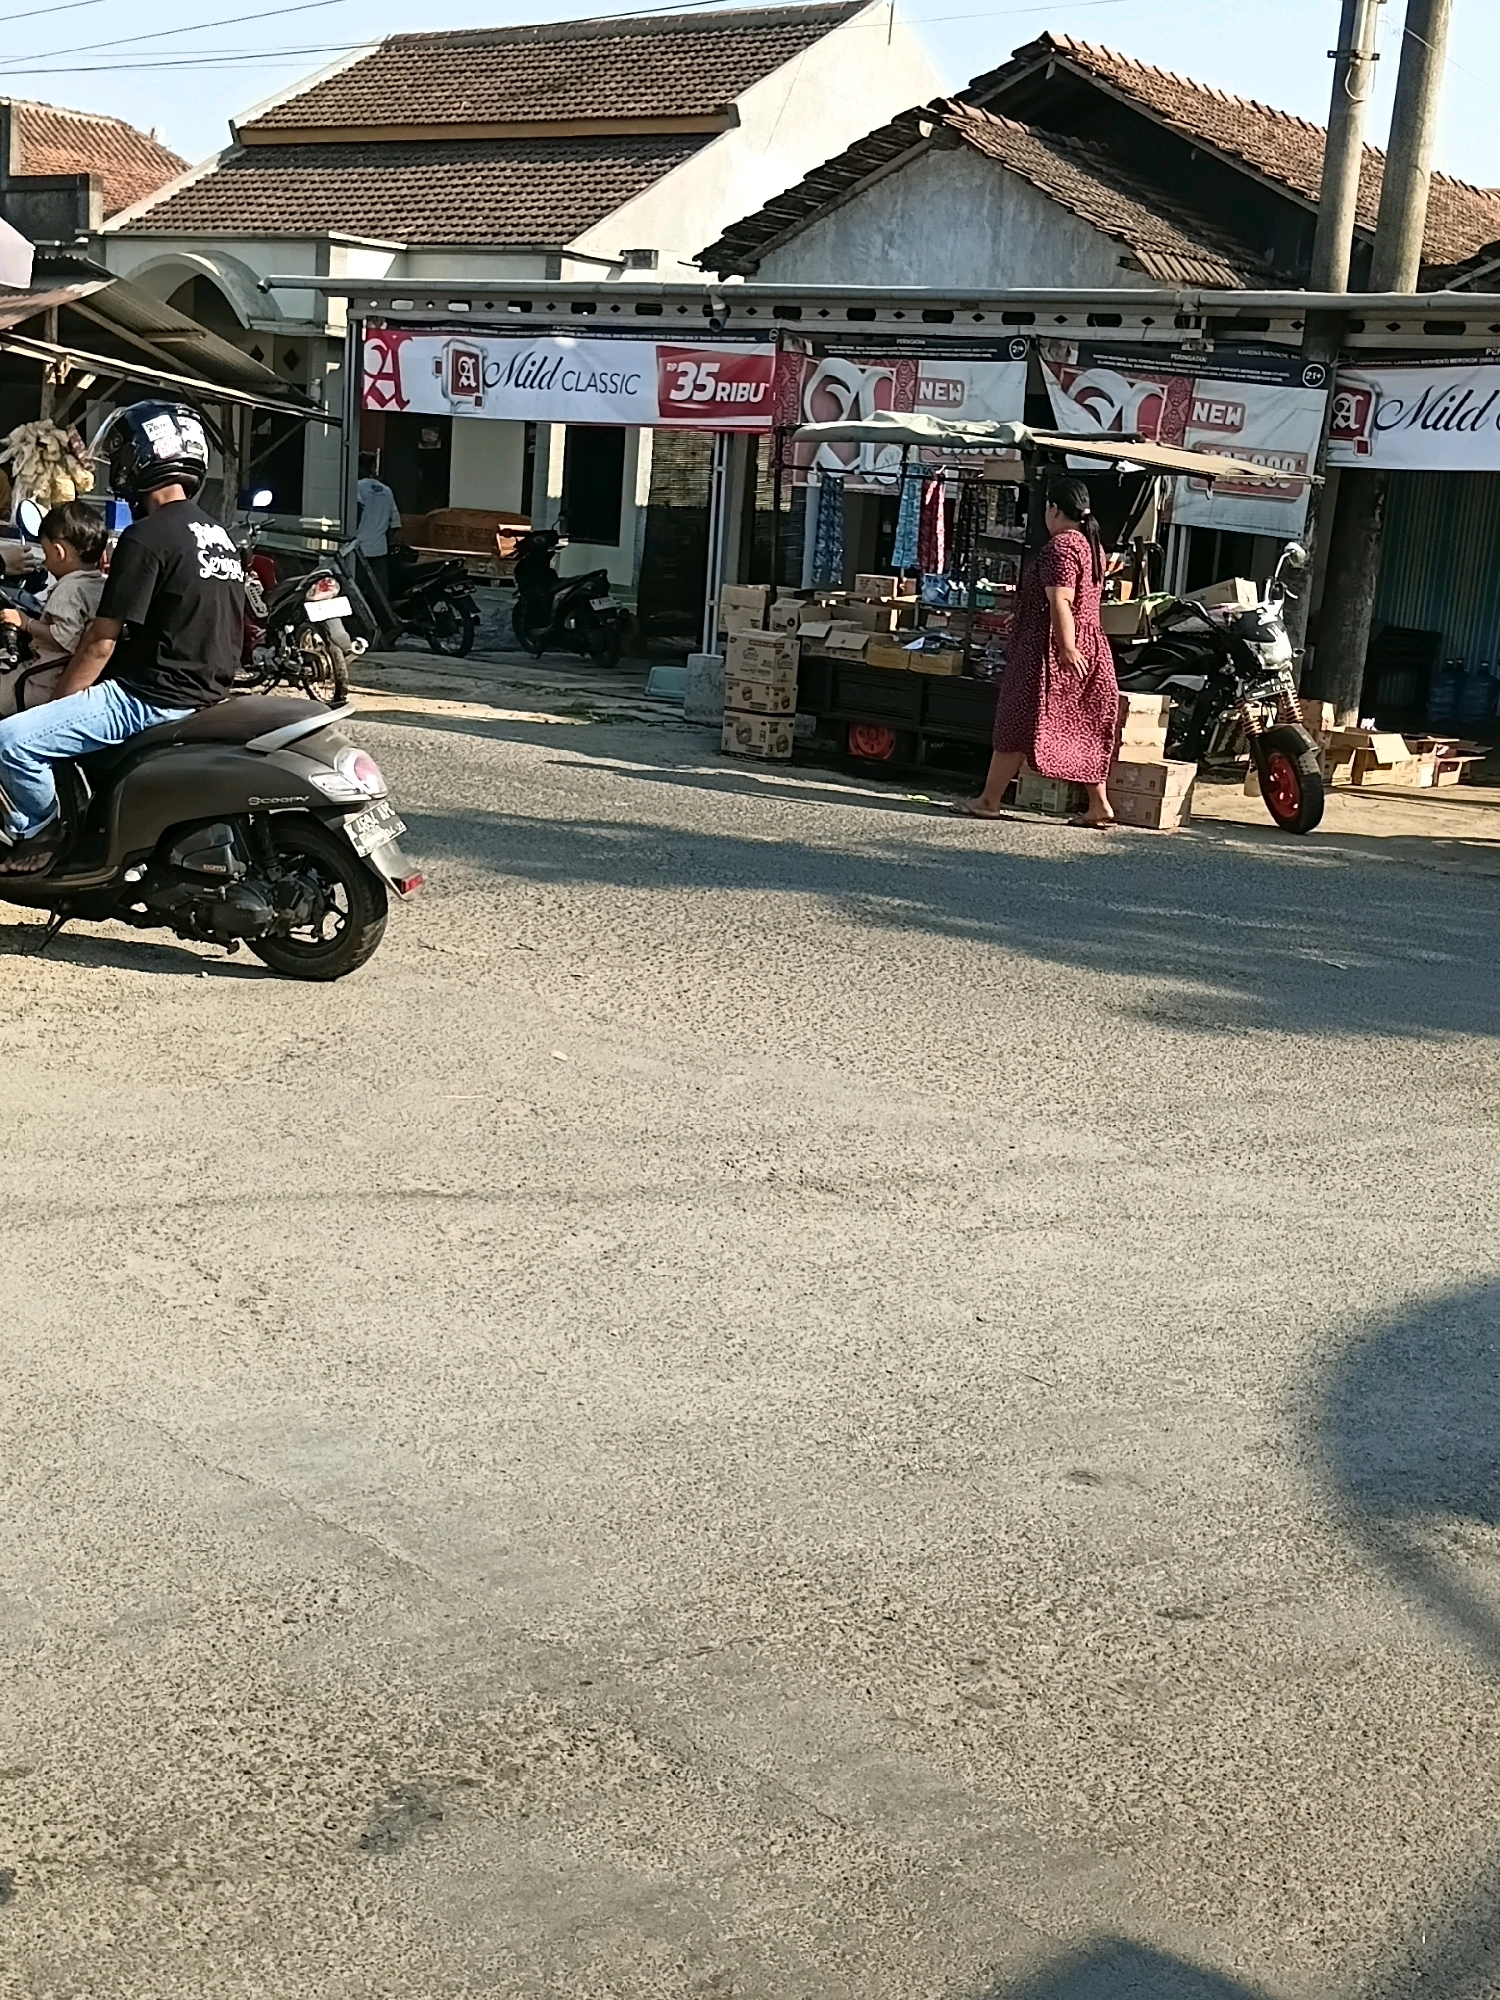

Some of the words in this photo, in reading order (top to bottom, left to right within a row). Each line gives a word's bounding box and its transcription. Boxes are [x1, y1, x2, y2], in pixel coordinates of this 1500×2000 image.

[483, 351, 564, 390] Mild
[561, 370, 641, 396] CLASSIC
[669, 361, 721, 402] 35
[1305, 371, 1322, 380] 21+
[919, 380, 962, 401] NEW
[1191, 401, 1243, 426] NEW
[1374, 384, 1500, 432] Mild
